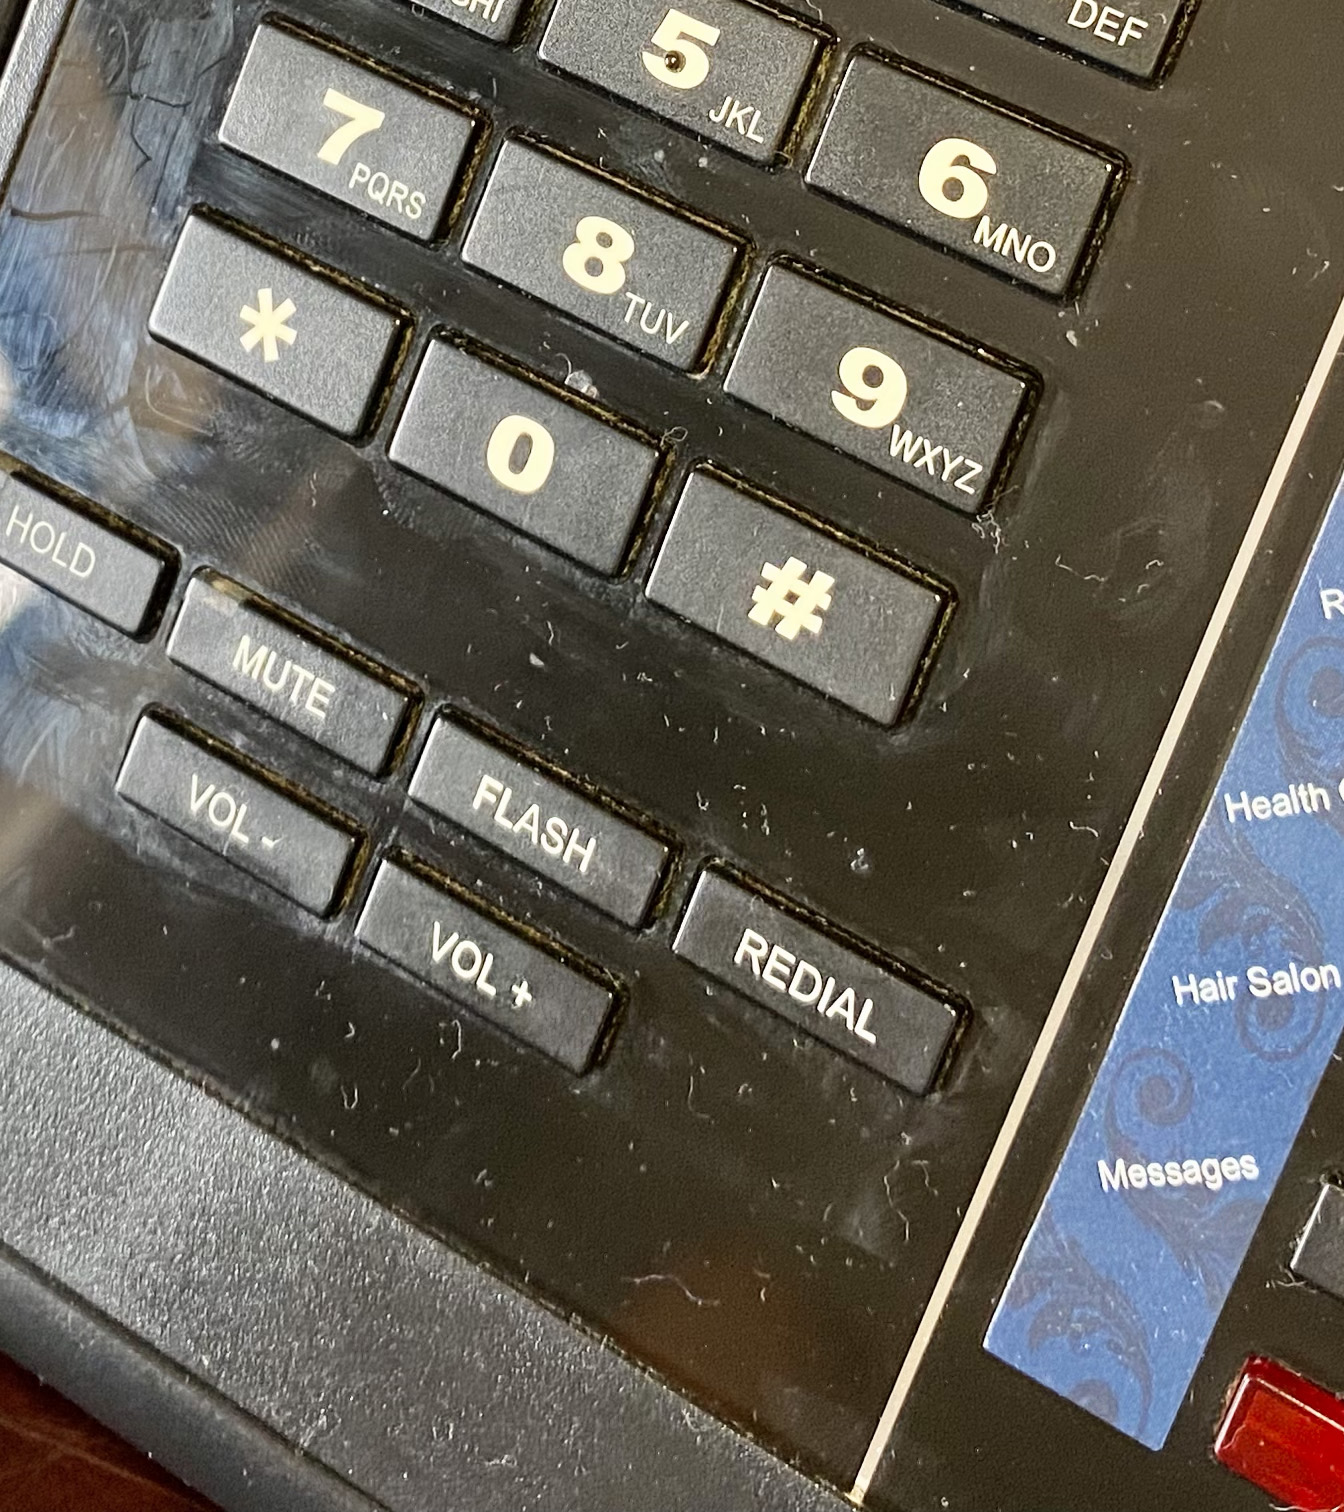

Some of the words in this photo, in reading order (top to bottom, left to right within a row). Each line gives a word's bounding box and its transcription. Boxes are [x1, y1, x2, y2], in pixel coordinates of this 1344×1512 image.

[642, 8, 720, 90] 5
[708, 94, 767, 144] JKL
[314, 88, 386, 166] 7
[347, 162, 427, 222] PQRS
[918, 137, 999, 219] 6
[972, 215, 1056, 272] MNO
[561, 215, 636, 296] 8
[622, 290, 690, 347] TUV
[486, 415, 556, 493] 0
[829, 346, 908, 429] 9
[888, 425, 984, 495] WXYZ
[4, 504, 97, 579] HOLD
[747, 555, 833, 641] #
[232, 635, 336, 720] MUTE
[188, 774, 251, 845] VOL
[472, 776, 597, 873] FLASH
[1224, 781, 1331, 826] Health
[428, 920, 498, 997] VOL
[734, 928, 878, 1044] REDIAL
[1172, 970, 1239, 1007] Hair
[1248, 960, 1342, 997] Salon
[1098, 1153, 1259, 1193] Messages
